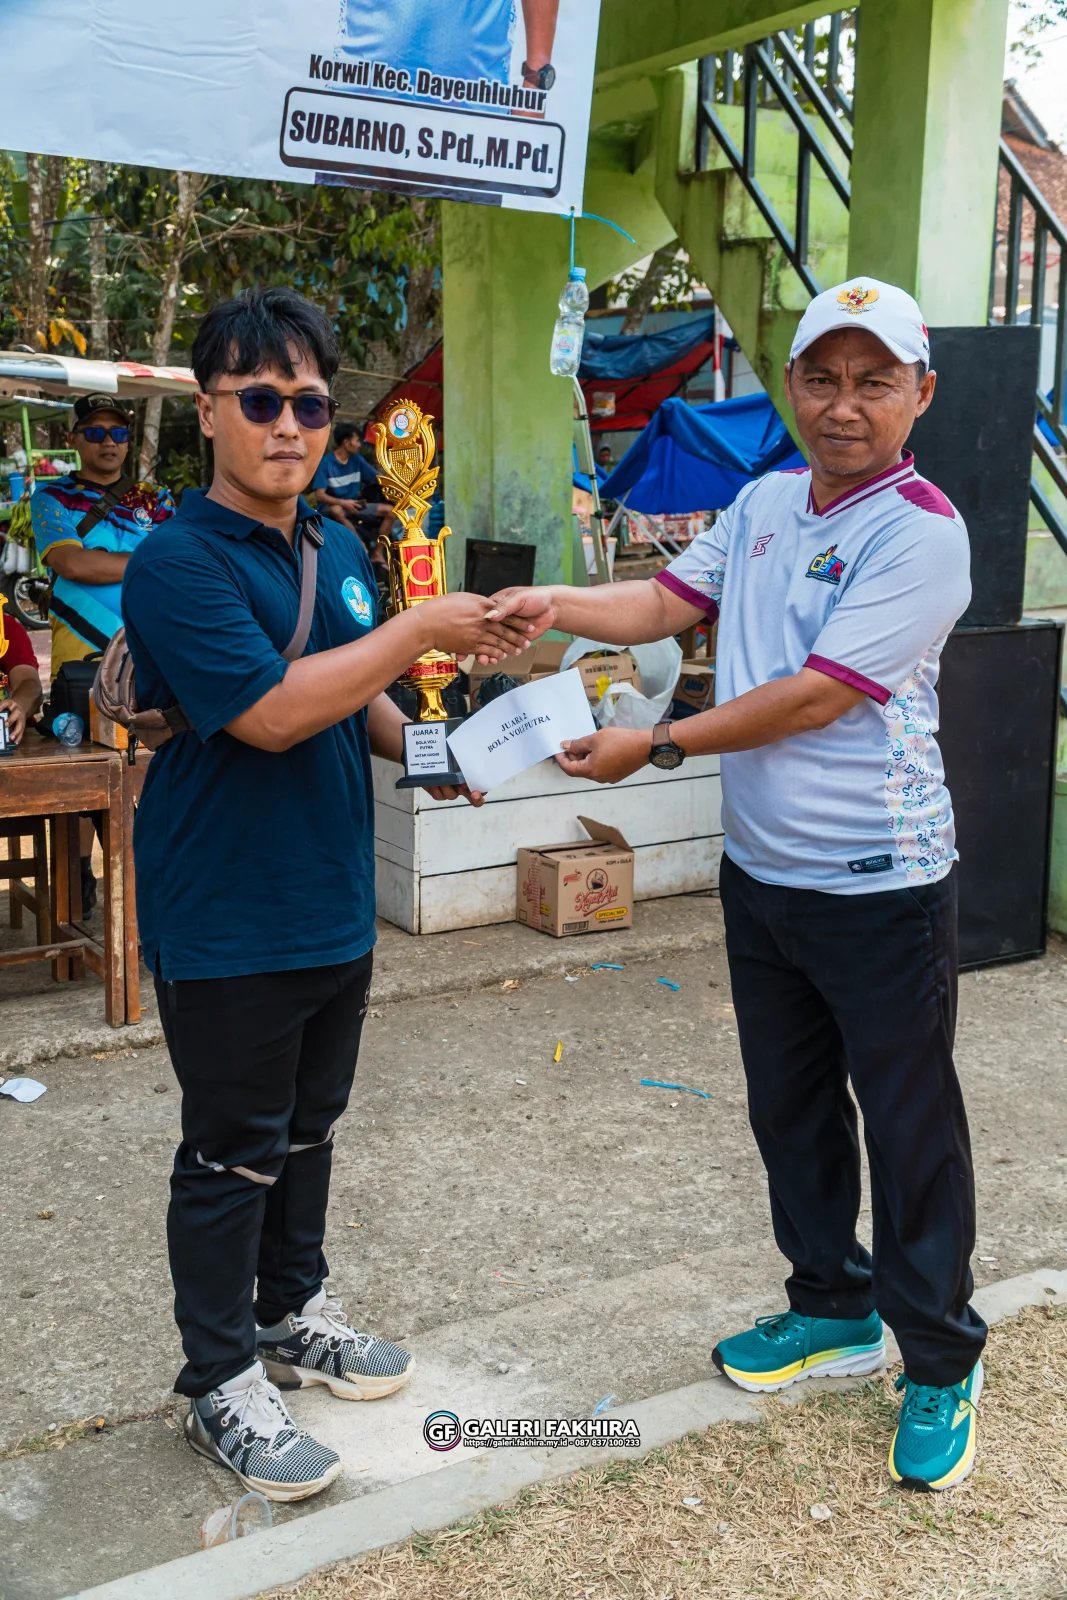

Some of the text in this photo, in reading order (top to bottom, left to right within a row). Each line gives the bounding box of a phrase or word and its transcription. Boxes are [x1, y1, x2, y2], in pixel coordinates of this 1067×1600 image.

[309, 54, 547, 111] Korwil Kec. Dayeuhluhur
[289, 110, 554, 174] SUBARNO, S.Pd.,M.Pd.
[487, 735, 510, 753] BOLA
[524, 714, 551, 731] PUTRA
[501, 712, 528, 732] JUARA 2
